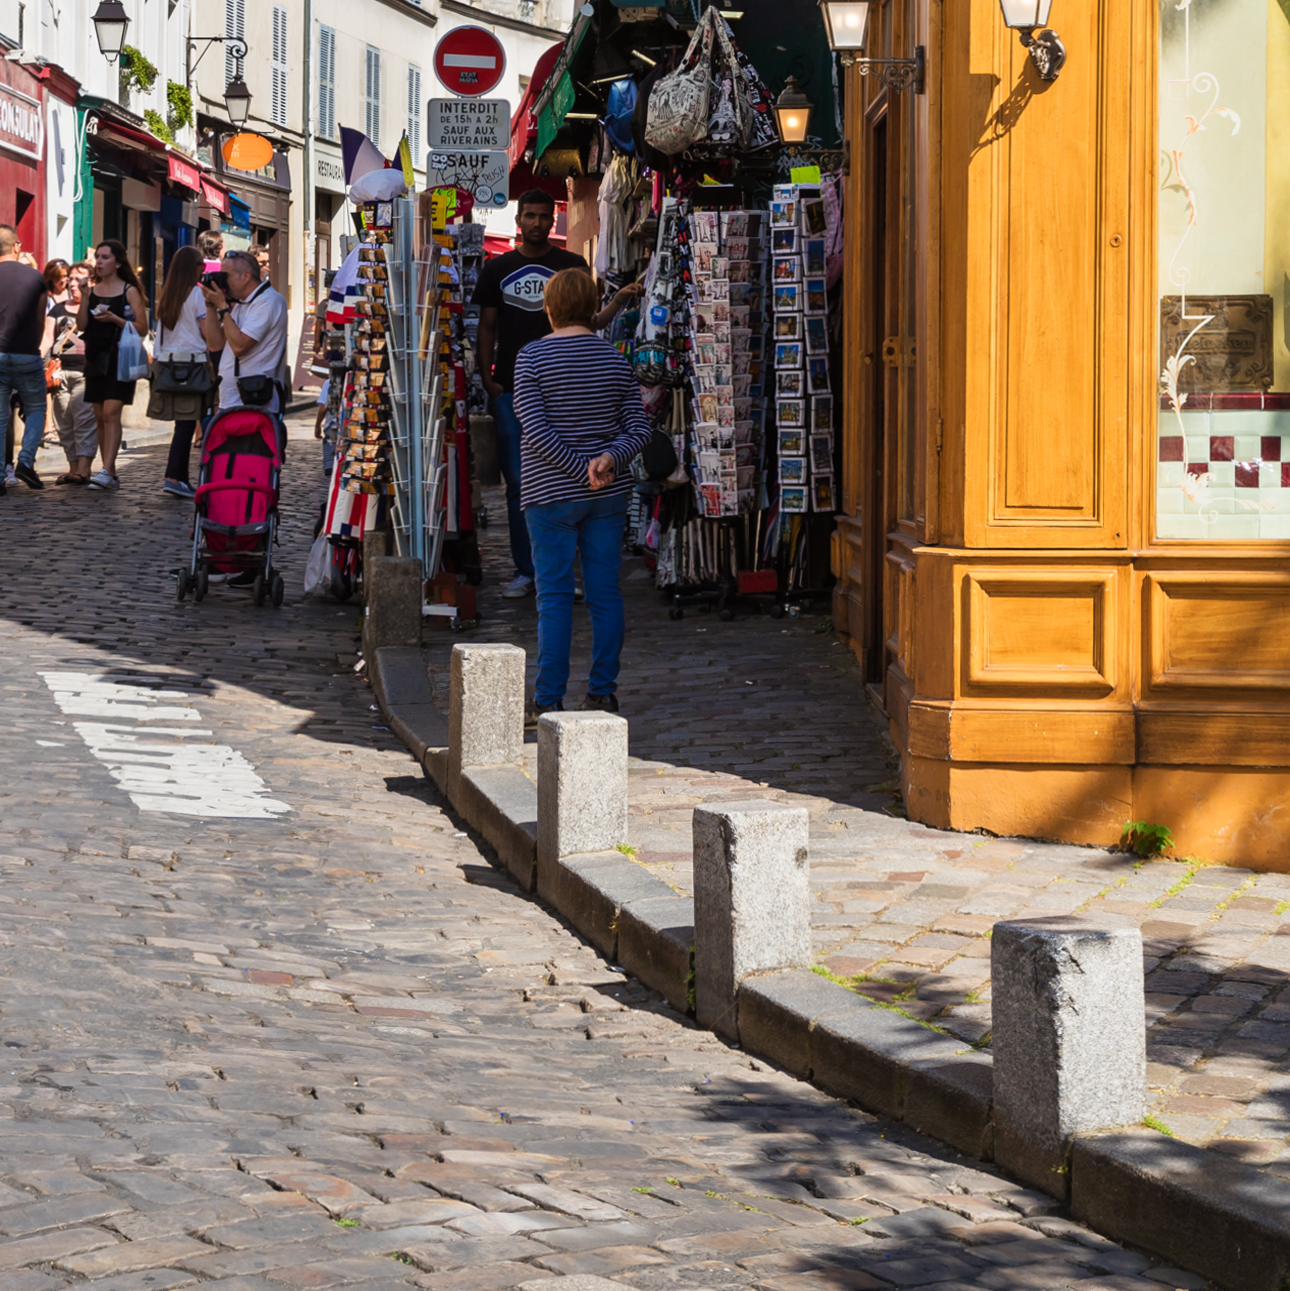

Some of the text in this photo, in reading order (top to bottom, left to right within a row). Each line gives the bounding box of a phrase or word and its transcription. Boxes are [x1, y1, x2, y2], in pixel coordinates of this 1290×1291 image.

[440, 103, 498, 114] INTERDIT
[454, 115, 471, 124] 15h
[476, 116, 482, 124] A
[486, 115, 498, 124] 2h
[443, 126, 495, 135] SAUF AUX
[441, 136, 497, 145] RIVERAINS
[447, 154, 489, 168] SAUF
[514, 280, 548, 295] G-STA
